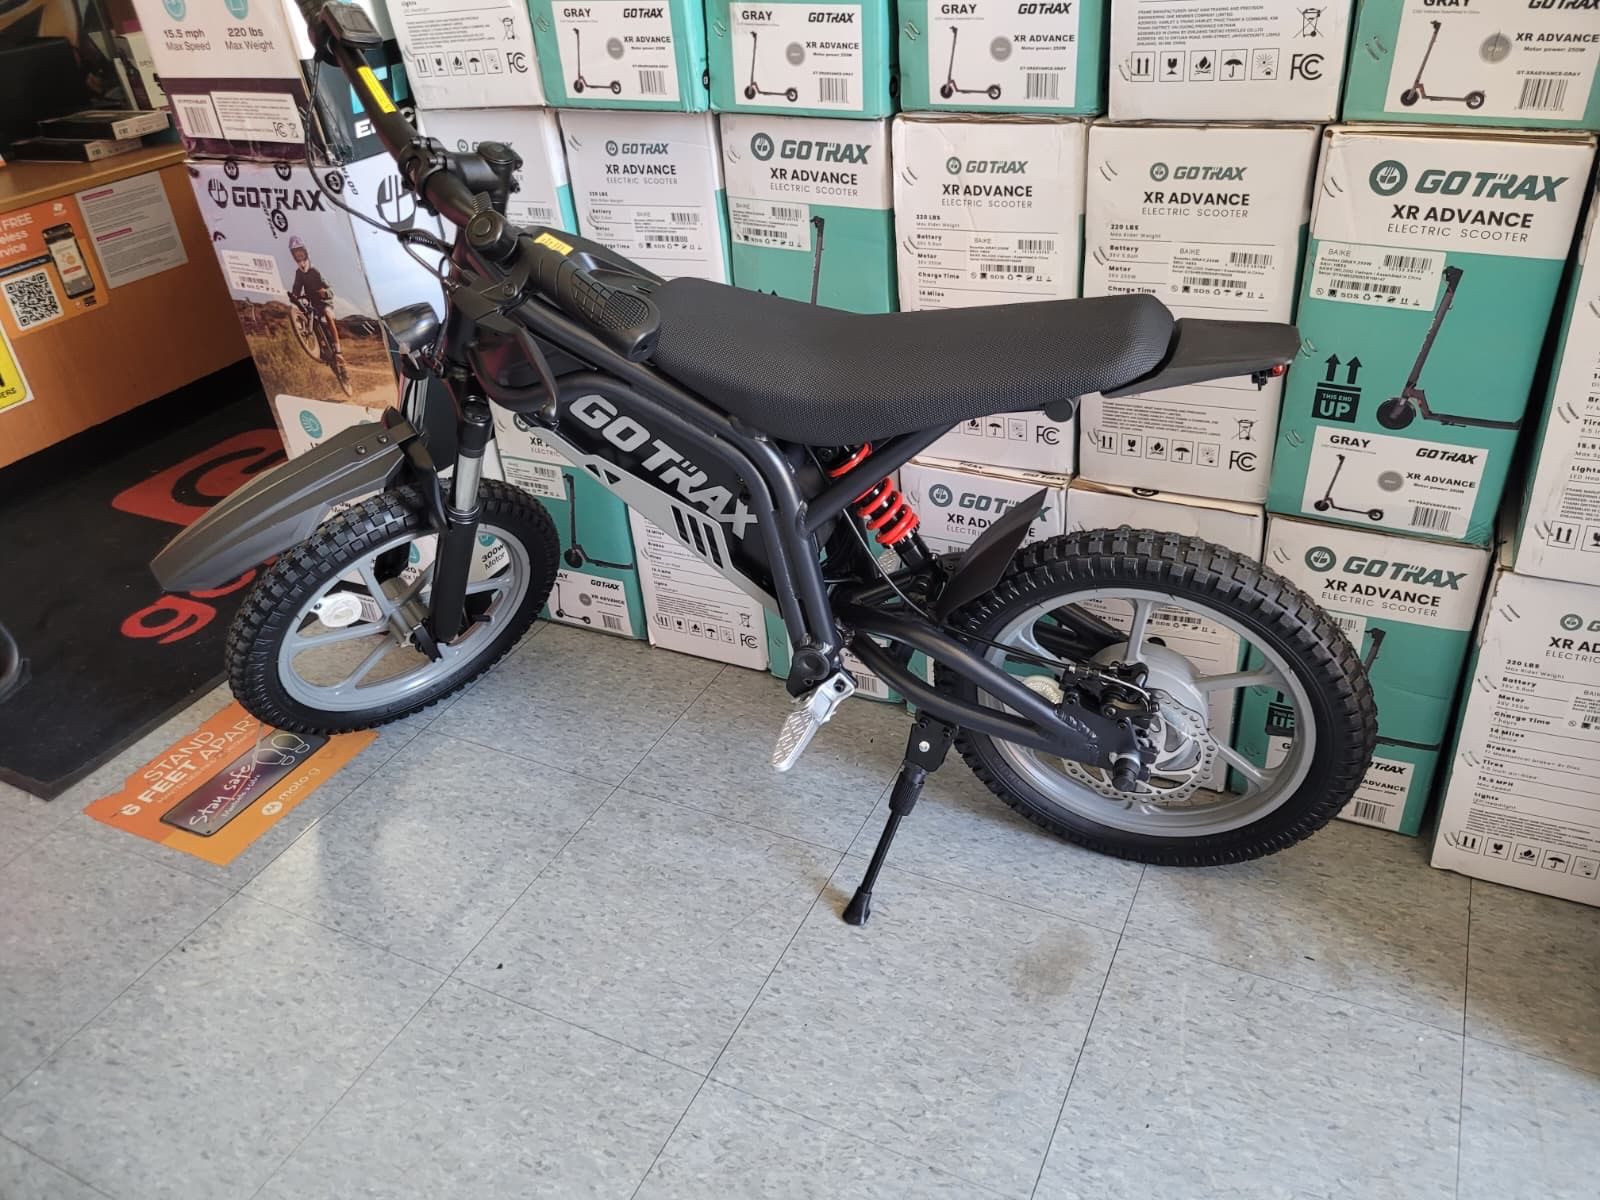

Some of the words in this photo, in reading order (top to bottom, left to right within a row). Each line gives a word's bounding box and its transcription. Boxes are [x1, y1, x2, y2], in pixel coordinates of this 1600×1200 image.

[563, 8, 591, 17] GRAY
[623, 8, 664, 18] GOTRAX
[742, 10, 772, 21] GRAY
[941, 4, 976, 14] GRAY
[1018, 3, 1071, 14] GOTRAX
[808, 12, 855, 23] GOTRAX
[163, 29, 184, 38] 15.5
[185, 29, 205, 39] mph
[227, 27, 247, 37] 220
[249, 27, 264, 37] lbs
[1014, 34, 1026, 42] XR
[1029, 34, 1075, 42] ADVANCE
[1516, 32, 1533, 42] XR
[1536, 33, 1600, 43] ADVANCE
[166, 41, 183, 50] Max
[184, 41, 211, 51] Speed
[225, 40, 243, 50] Max
[244, 40, 275, 52] Weight
[622, 143, 669, 154] GOTRAX
[780, 139, 872, 164] GOTRAX
[605, 164, 620, 174] XR
[622, 164, 677, 175] ADVANCE
[965, 160, 1029, 174] GOTRAX
[1173, 166, 1248, 181] GOTRAX
[770, 167, 787, 180] XR
[790, 169, 858, 185] ADVANCE
[769, 182, 810, 192] ELECTRIC
[815, 186, 858, 197] SCOOTER
[942, 184, 960, 195] XR
[963, 185, 1032, 197] ADVANCE
[1414, 169, 1569, 202] GOTRAX
[231, 186, 326, 211] GOTRAX
[941, 199, 982, 208] ELECTRIC
[988, 200, 1032, 208] SCOOTER
[1143, 191, 1164, 204] XR
[1167, 192, 1250, 206] ADVANCE
[1142, 207, 1190, 216] ELECTRIC
[1196, 209, 1248, 218] SCOOTER
[1391, 204, 1420, 221] XR
[1423, 207, 1534, 229] ADVANCE
[1, 212, 33, 231] FREE
[1387, 223, 1451, 237] ELECTRIC
[1460, 228, 1528, 242] SCOOTER
[1109, 245, 1139, 253] Battery
[1320, 401, 1351, 418] UP
[529, 436, 543, 447] XR
[1329, 434, 1371, 449] GRAY
[1415, 447, 1478, 465] GOTRAX
[569, 394, 759, 540] GOTRAX
[1406, 472, 1421, 480] XR
[1424, 476, 1476, 489] ADVANCE
[947, 513, 965, 525] XR
[484, 552, 506, 571] Motor
[1343, 556, 1469, 590] GOTRAX
[590, 579, 620, 591] GOTRAX
[1323, 578, 1347, 592] XR
[1350, 583, 1441, 607] ADVANCE
[1321, 591, 1375, 608] ELECTRIC
[1381, 601, 1438, 617] SCOOTER
[1548, 636, 1575, 650] XR
[1502, 677, 1537, 687] Battery
[1498, 694, 1525, 702] Motor
[1494, 711, 1527, 722] Charge
[1529, 717, 1550, 725] Time
[1501, 729, 1524, 738] Miles
[1486, 743, 1517, 753] Brakes
[143, 731, 215, 782] STAND
[137, 759, 198, 803] FEET
[279, 775, 309, 800] moto
[189, 795, 235, 825] Stay
